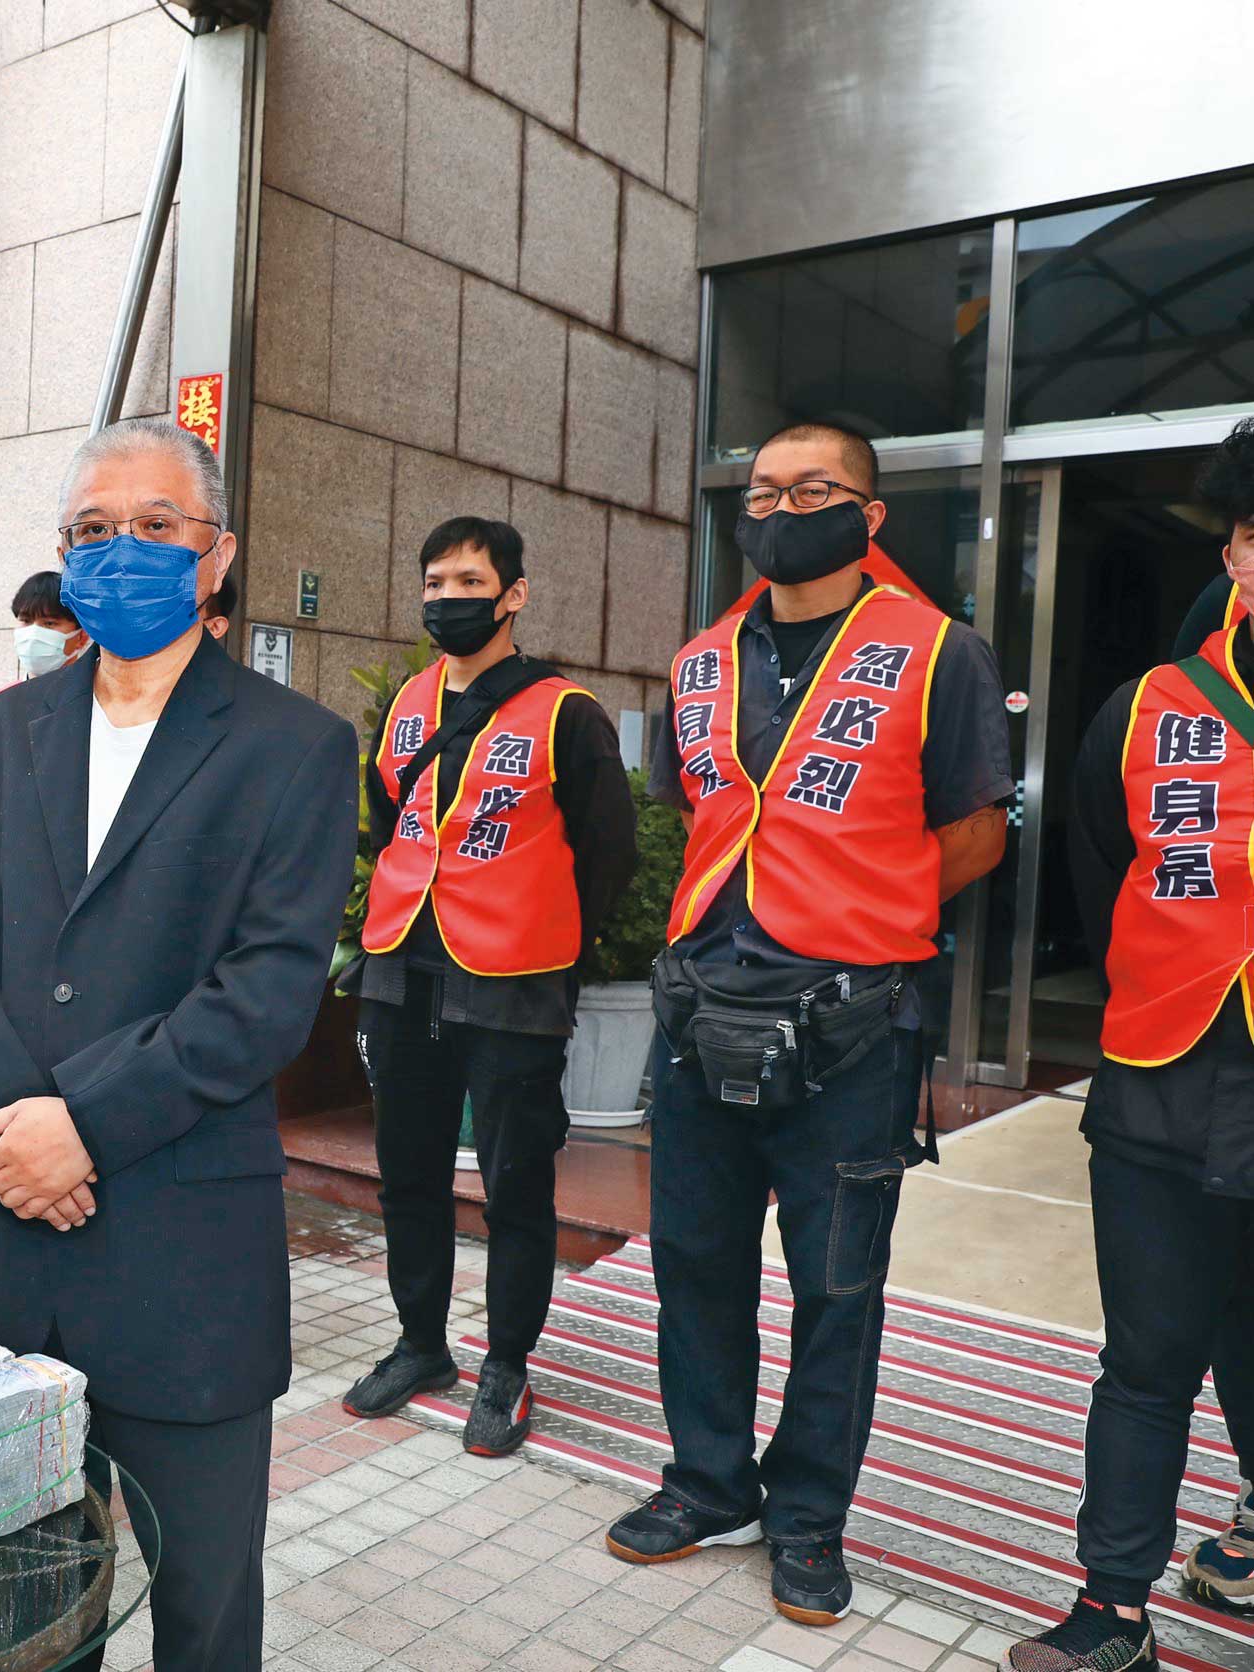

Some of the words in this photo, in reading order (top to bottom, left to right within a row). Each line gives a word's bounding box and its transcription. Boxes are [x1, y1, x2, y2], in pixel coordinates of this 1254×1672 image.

[457, 732, 535, 862] 忽必烈
[784, 642, 914, 814] 忽必烈
[1149, 710, 1227, 900] 健身房
